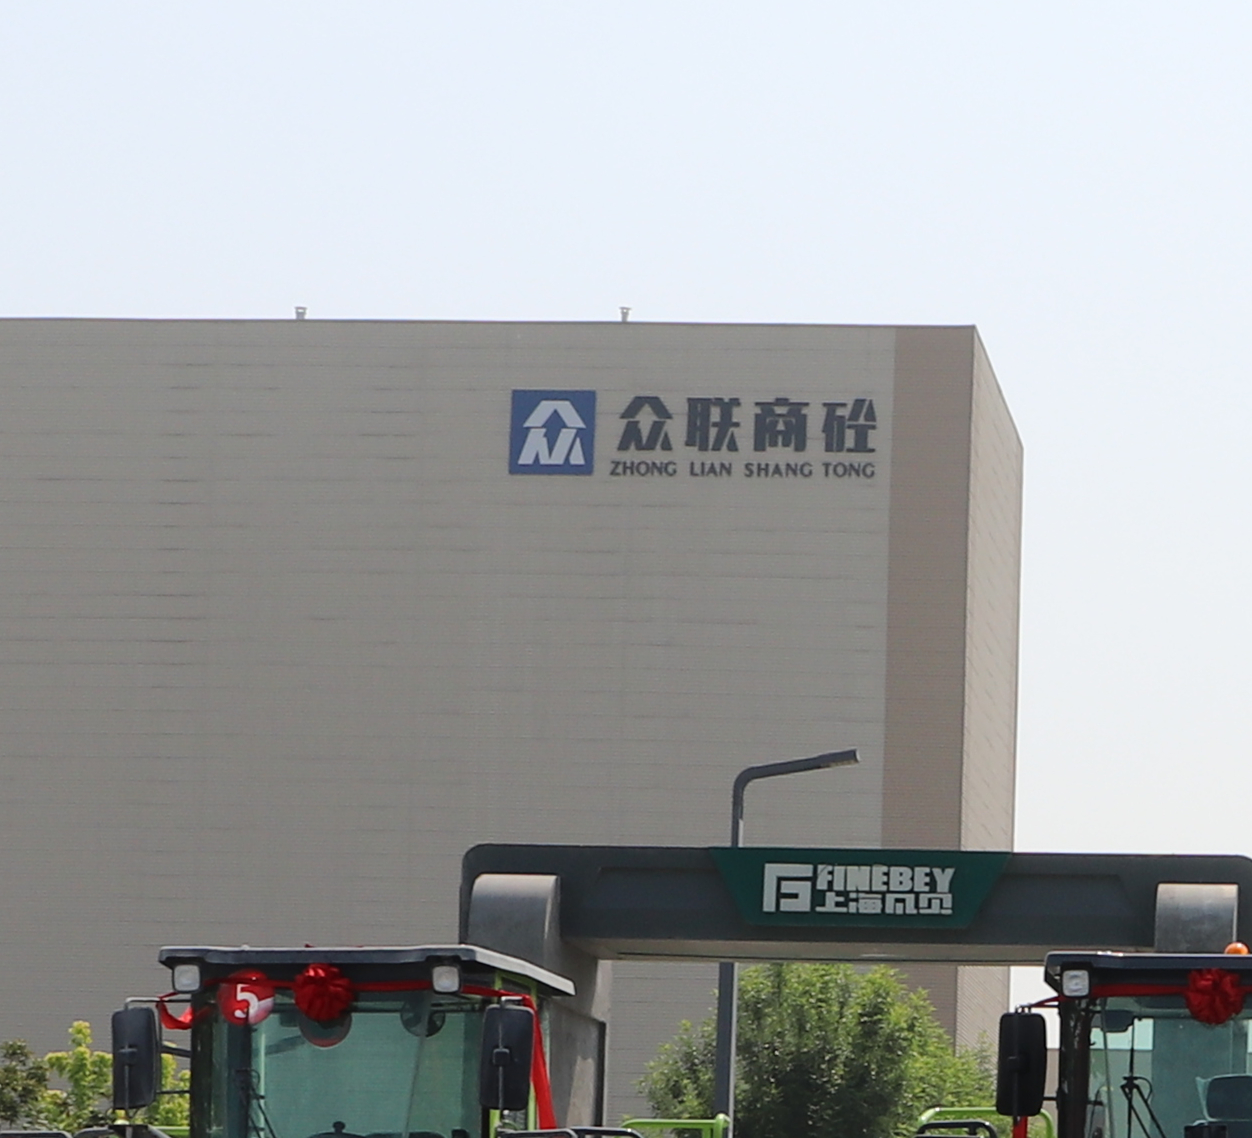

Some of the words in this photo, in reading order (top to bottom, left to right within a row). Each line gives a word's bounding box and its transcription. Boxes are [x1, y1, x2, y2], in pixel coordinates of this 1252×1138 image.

[616, 395, 877, 453] 众联商砼
[609, 460, 677, 477] ZHONG
[689, 462, 732, 477] LIAN
[744, 462, 813, 478] SHANG
[822, 462, 875, 478] TONG
[816, 864, 955, 893] FINEBEY
[234, 983, 259, 1018] 5
